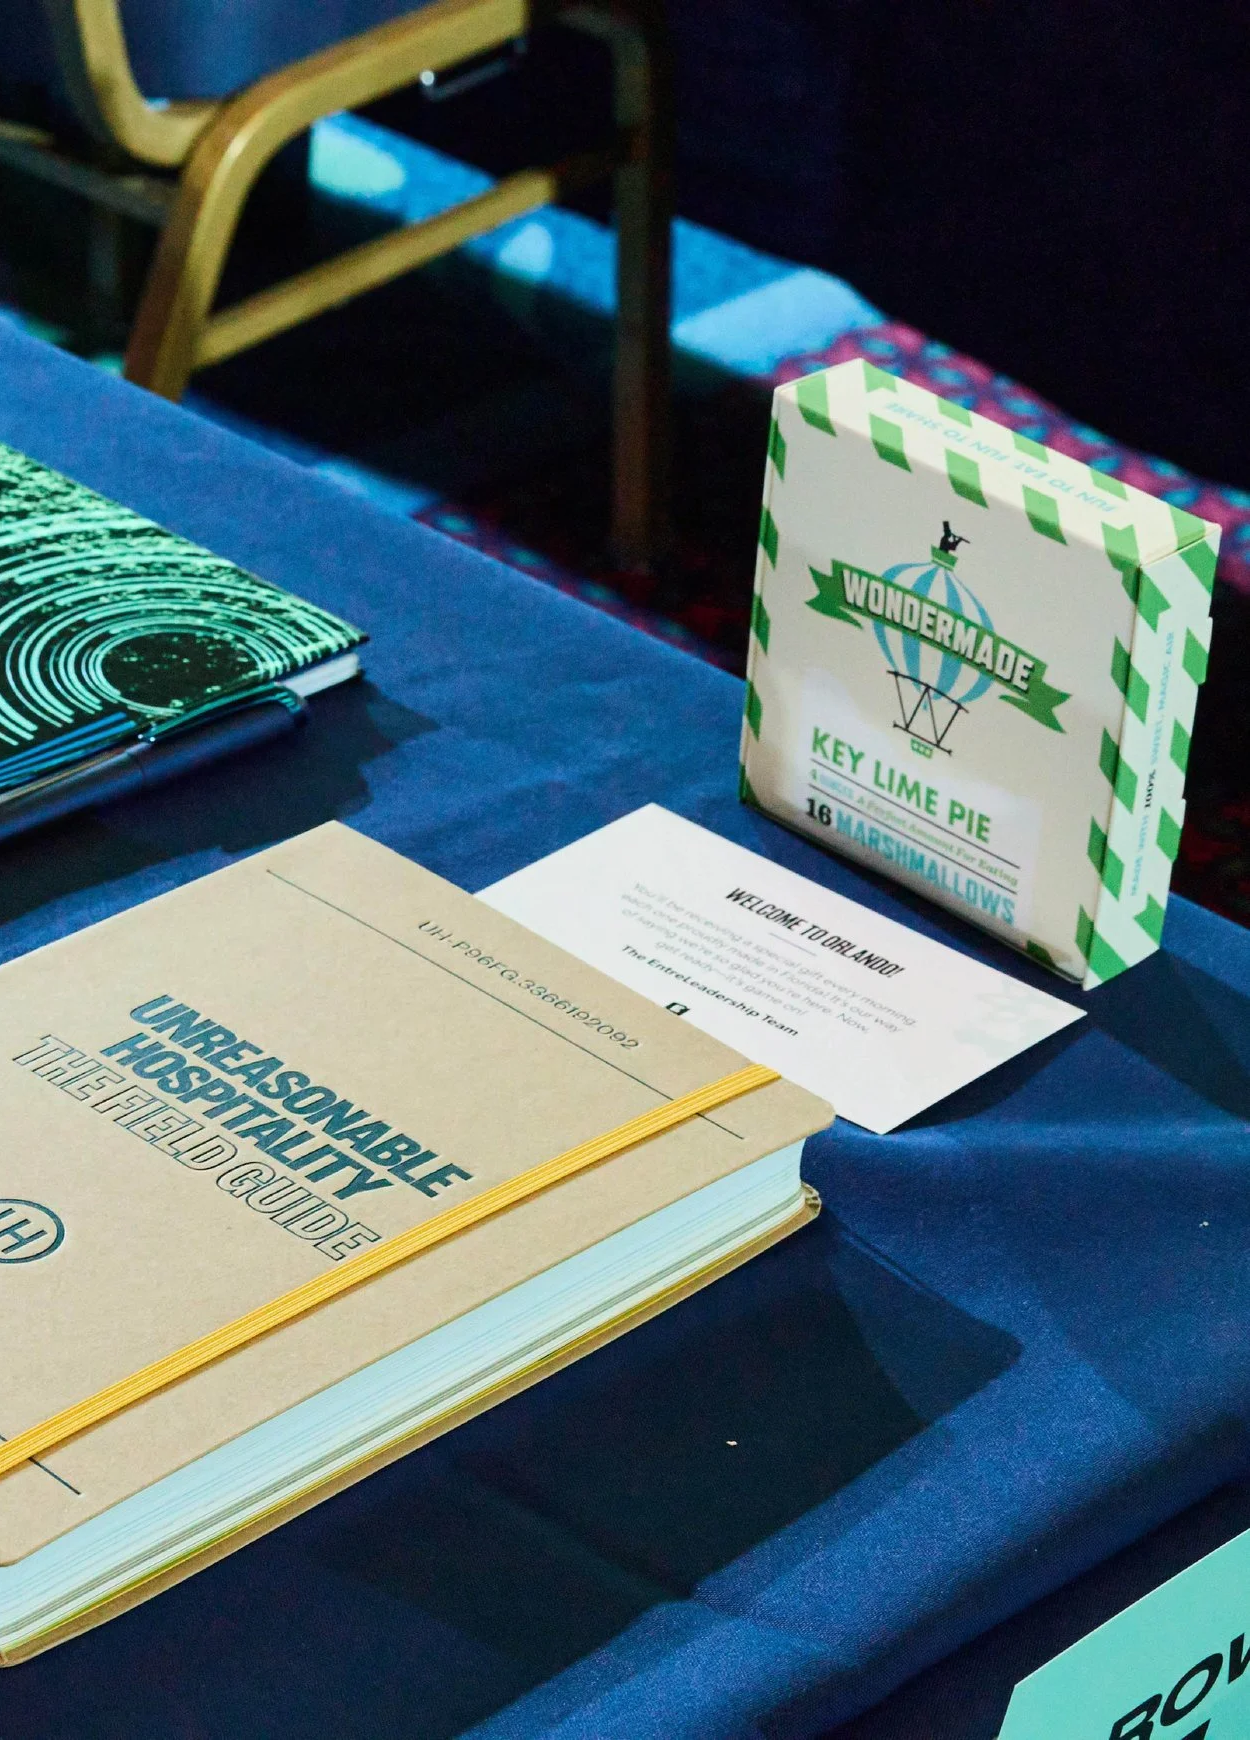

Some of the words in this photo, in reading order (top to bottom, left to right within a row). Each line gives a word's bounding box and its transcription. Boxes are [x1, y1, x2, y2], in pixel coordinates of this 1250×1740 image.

[842, 568, 1036, 692] WONDERMADE
[811, 726, 865, 775] KEY
[874, 759, 939, 817] LIME
[948, 799, 992, 844] PIE
[806, 798, 833, 827] 16
[836, 808, 1017, 926] MARSHMALLOWS
[622, 944, 647, 961] The
[646, 957, 760, 1017] EntreLeadership
[762, 1013, 799, 1037] Team
[725, 887, 807, 932] WELCOME
[800, 924, 829, 941] TO
[820, 935, 906, 979] ORLANDO!
[11, 1033, 126, 1102] THE
[90, 1085, 239, 1172] FIELD
[216, 1161, 383, 1262] GUIDE
[99, 1031, 395, 1201] HOSPITALITY
[129, 993, 475, 1200] UNREASONABLE
